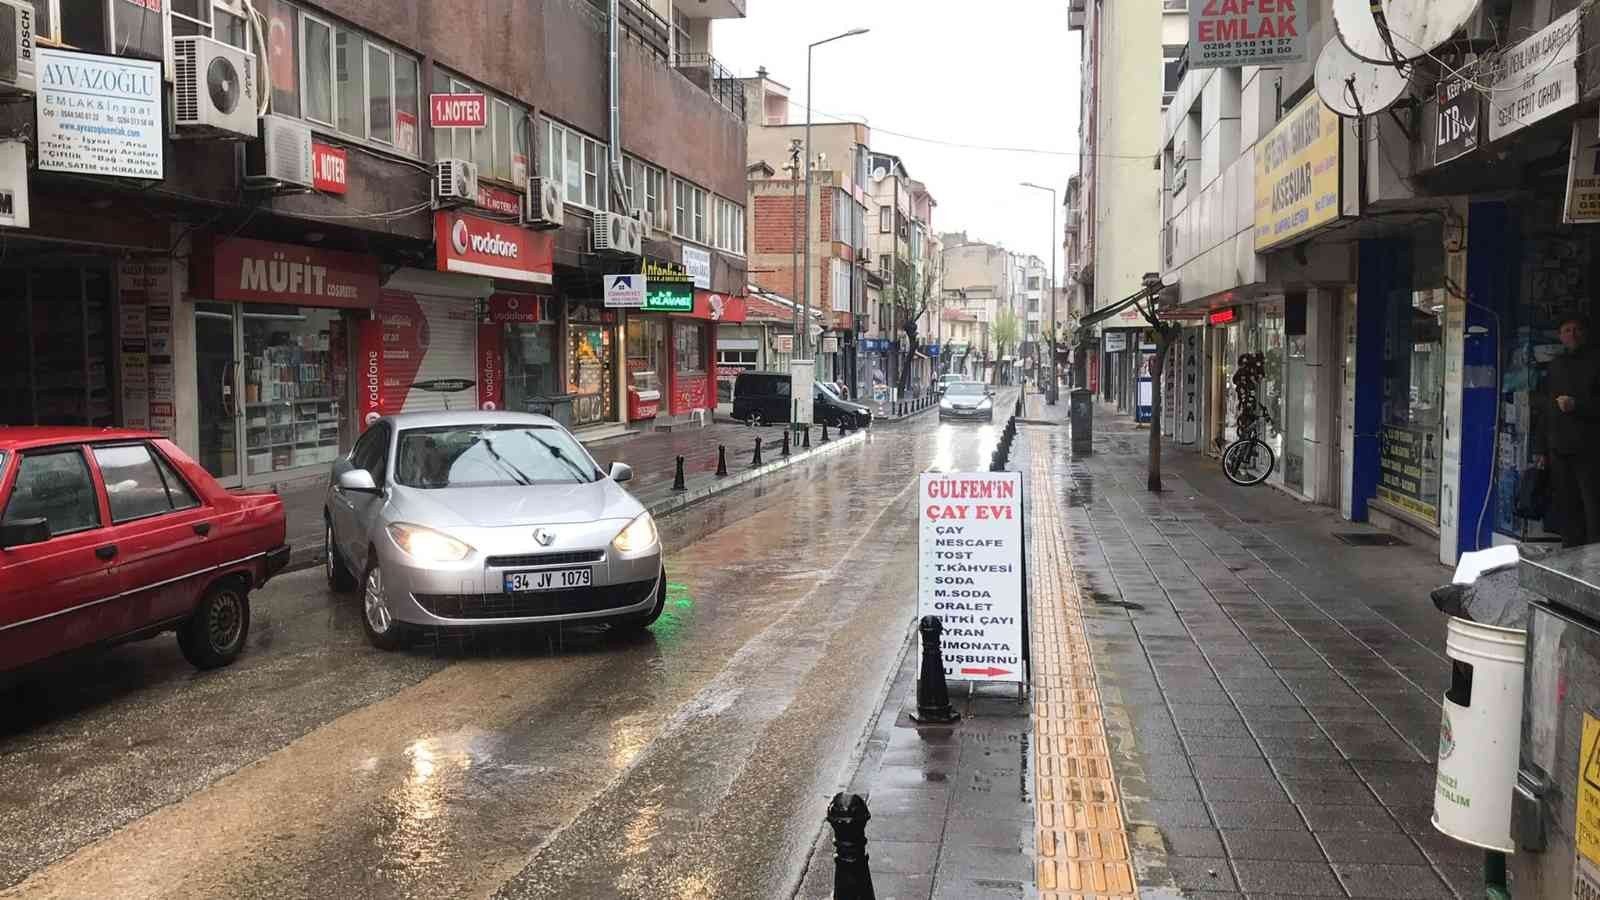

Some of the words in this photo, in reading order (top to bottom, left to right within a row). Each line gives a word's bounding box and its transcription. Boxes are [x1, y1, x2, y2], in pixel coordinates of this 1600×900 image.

[1202, 0, 1295, 16] ZAFER
[22, 10, 31, 58] BOSCH
[1199, 16, 1297, 42] EMLAK
[42, 63, 153, 97] AYVAZOĞLU
[436, 99, 481, 121] 1.NOTER
[321, 152, 345, 184] NOTER
[1272, 161, 1312, 215] AKSESUAR
[470, 231, 518, 258] vodafone
[240, 251, 328, 295] MÜFİT
[495, 311, 534, 321] vodafone
[367, 351, 378, 408] vodafone
[927, 504, 969, 523] ÇAY
[935, 526, 964, 536] ÇAY
[935, 539, 1004, 547] NESCAFE
[935, 551, 973, 559] TOST
[935, 563, 1012, 573] T.KAHVESİ
[513, 574, 529, 590] 34
[537, 572, 552, 589] JV
[562, 570, 590, 586] 1079
[935, 576, 975, 585] SODA
[934, 590, 991, 598] M.SODA
[934, 602, 993, 611] ORALET
[980, 616, 1014, 626] ÇAYI
[940, 640, 1010, 651] İMONATA
[943, 654, 1018, 664] UŞBURNU
